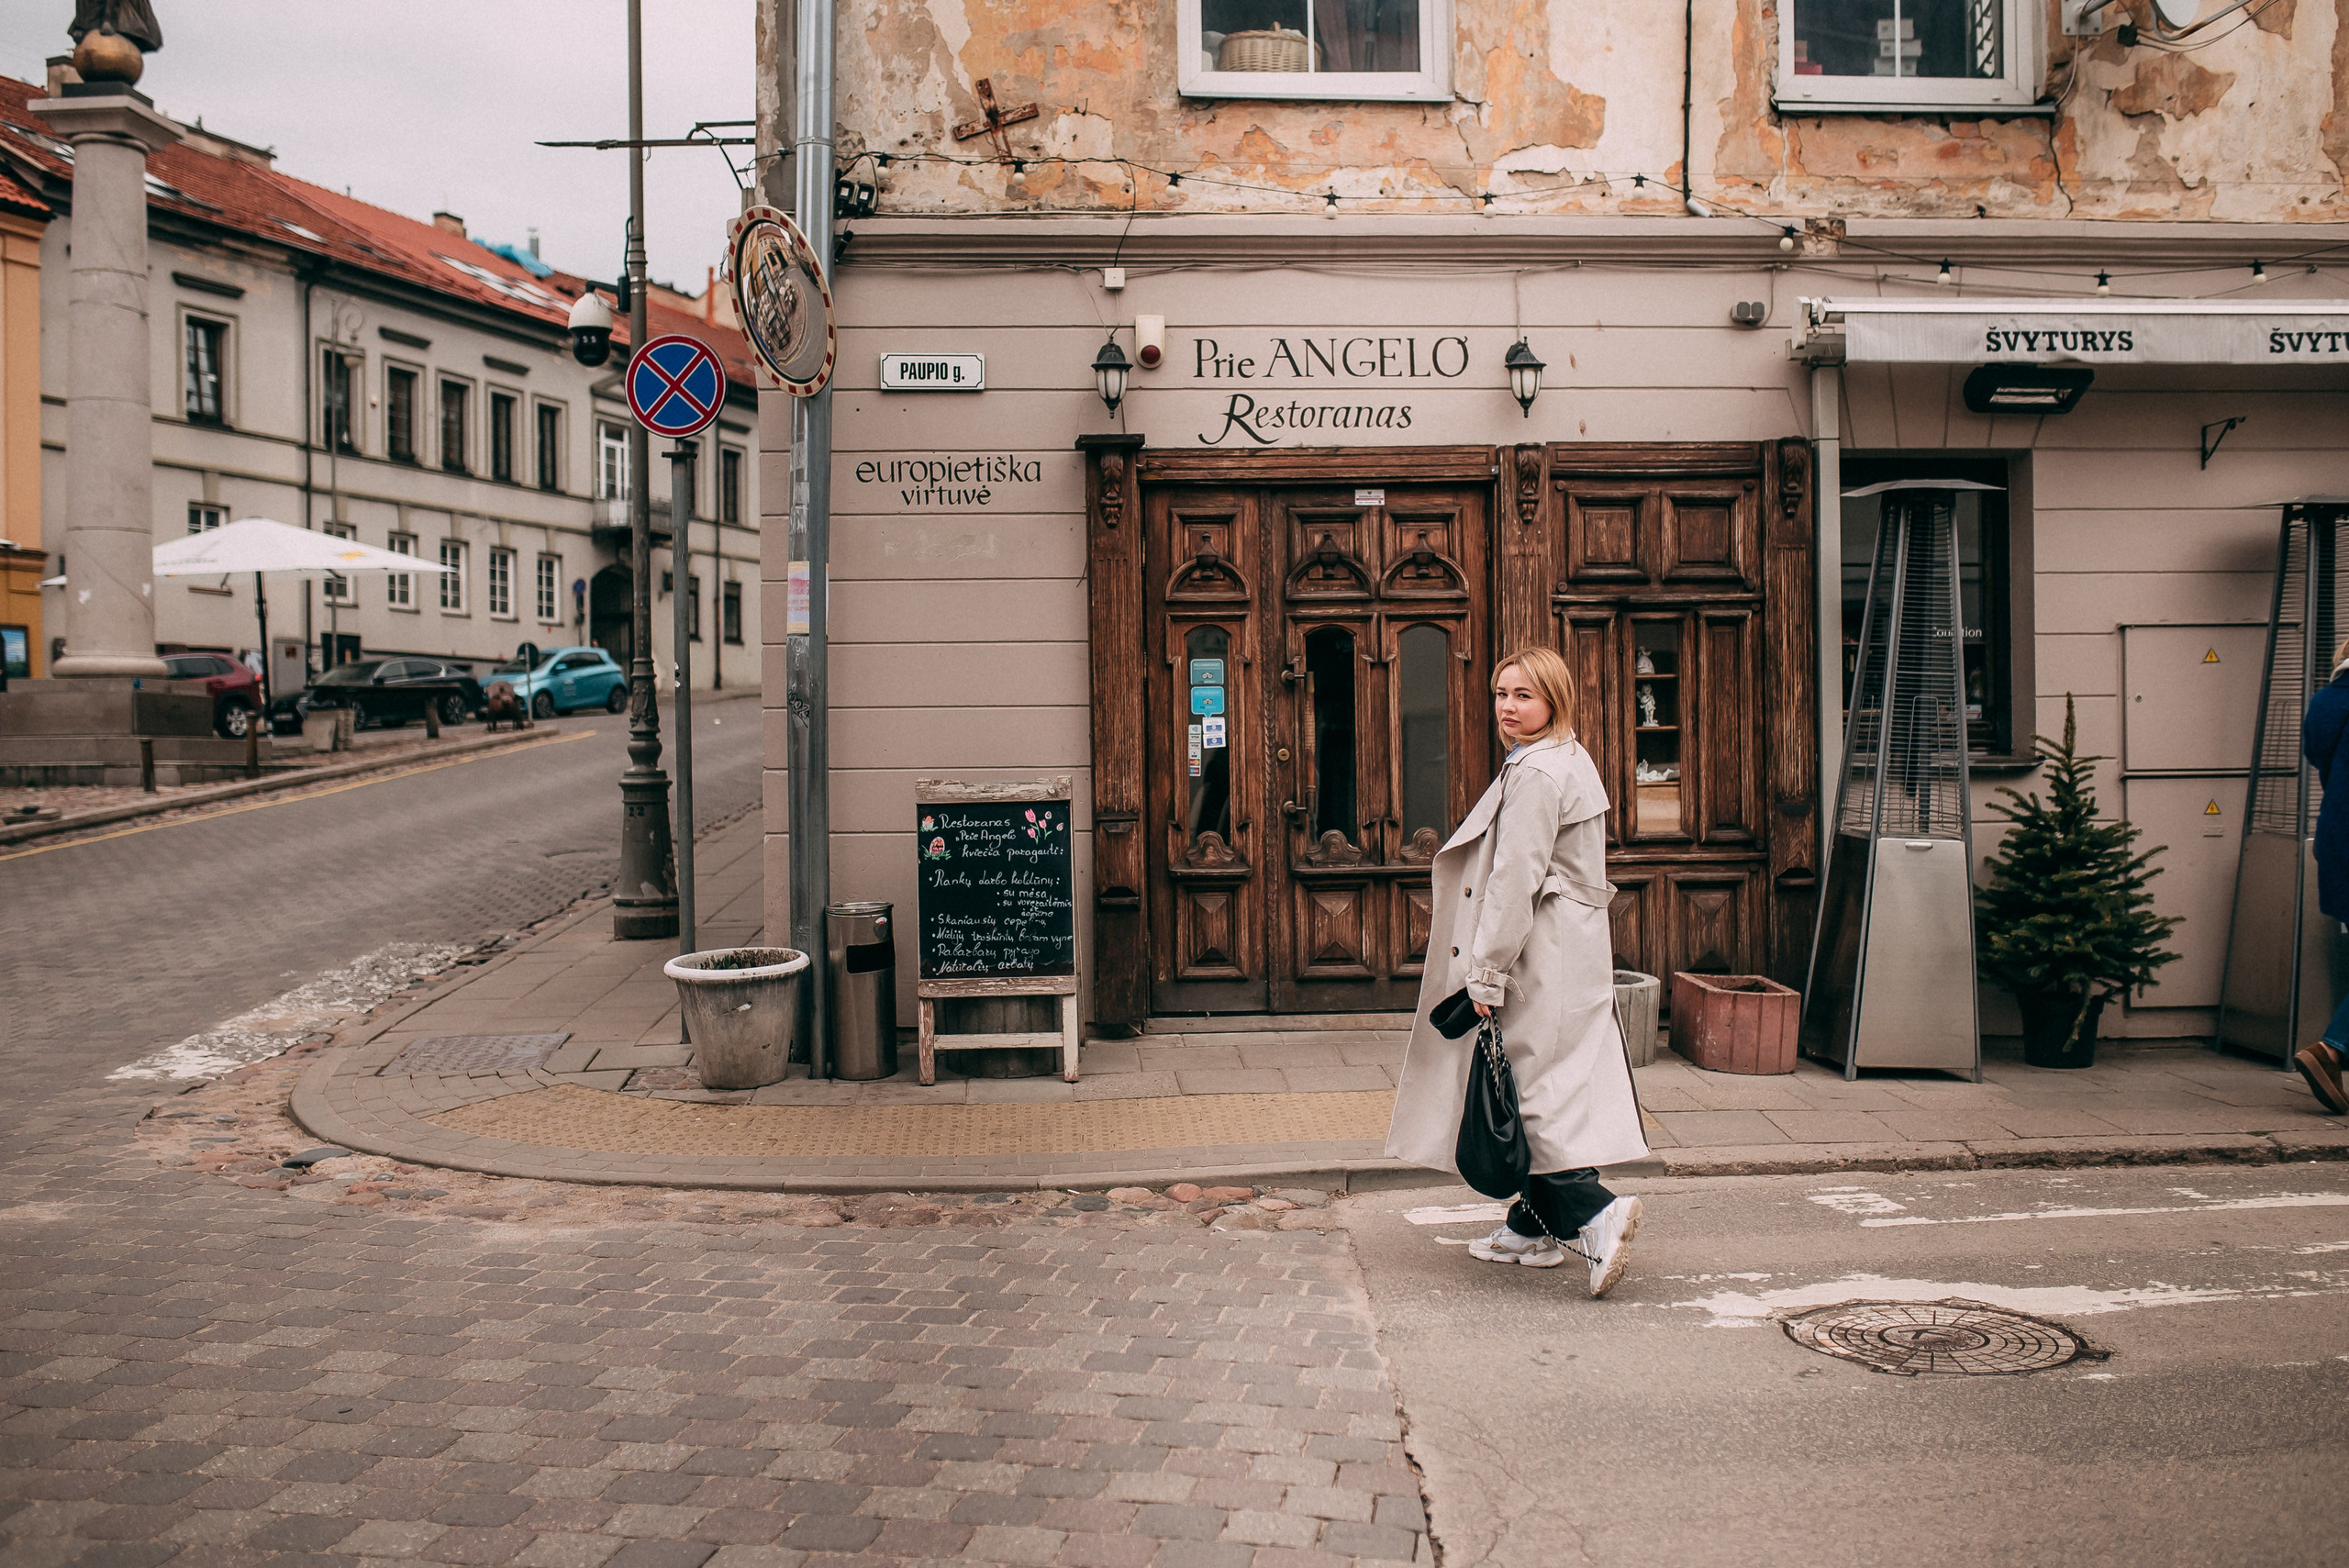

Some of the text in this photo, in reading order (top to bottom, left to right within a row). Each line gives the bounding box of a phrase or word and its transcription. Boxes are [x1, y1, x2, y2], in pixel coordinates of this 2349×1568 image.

[1986, 326, 2134, 352] ŠVYTURYS
[1193, 336, 1470, 378] Prie ANGELO
[900, 361, 965, 383] PAUPIO g.
[1197, 393, 1413, 445] Restoranas
[855, 454, 1042, 488] europietiška
[900, 484, 992, 506] virtuvė
[939, 813, 1011, 828] Restoranas
[962, 844, 1000, 857] kviečia
[933, 869, 972, 888] Rankų
[978, 870, 1008, 885] darbo
[1003, 888, 1015, 897] su
[1003, 899, 1013, 907] su
[1051, 935, 1074, 950] vyne
